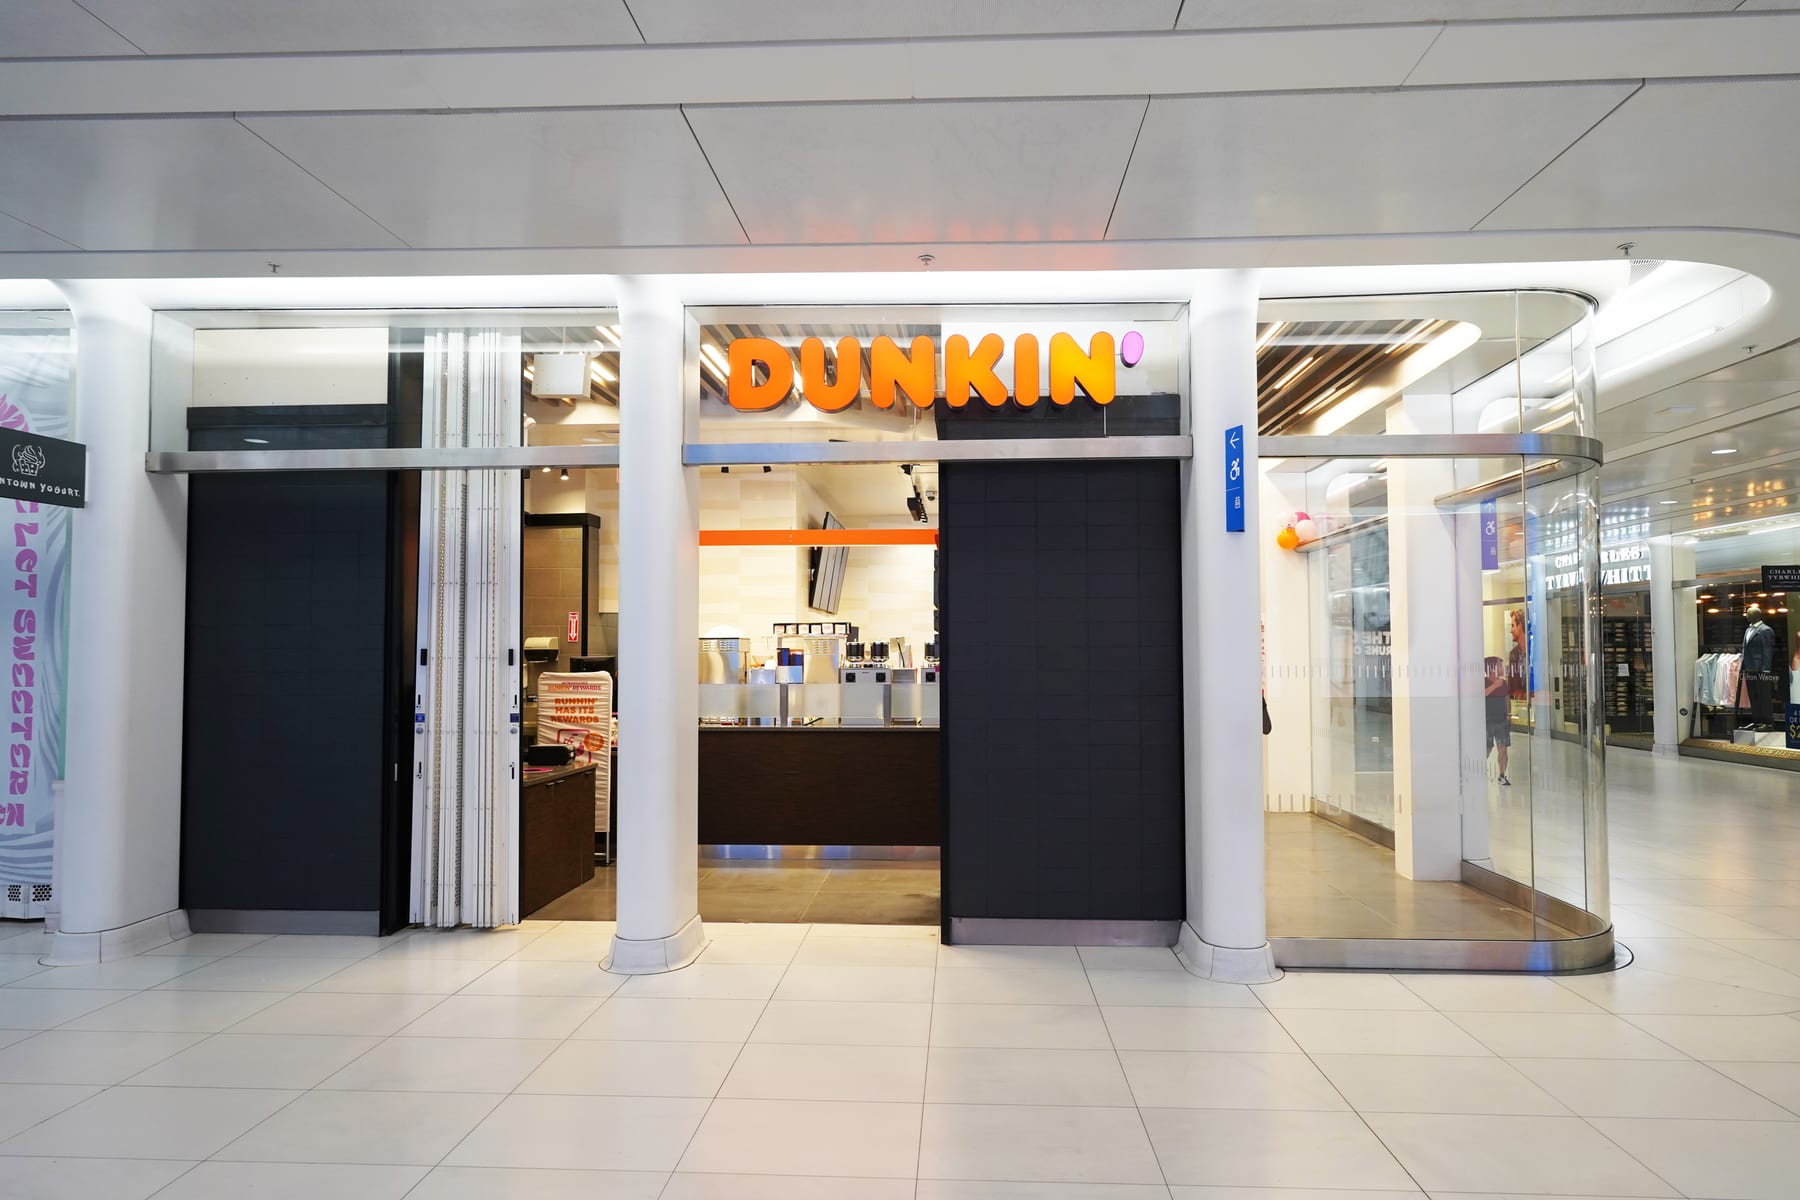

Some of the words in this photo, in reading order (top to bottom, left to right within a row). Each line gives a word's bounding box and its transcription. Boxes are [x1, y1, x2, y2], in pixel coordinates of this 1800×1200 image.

[728, 331, 1144, 412] DUNKIN'
[9, 609, 36, 795] SWEETER
[554, 697, 598, 705] RUNNIN'
[555, 706, 576, 714] HAS
[579, 706, 594, 714] ITS
[550, 715, 599, 724] REWARDS
